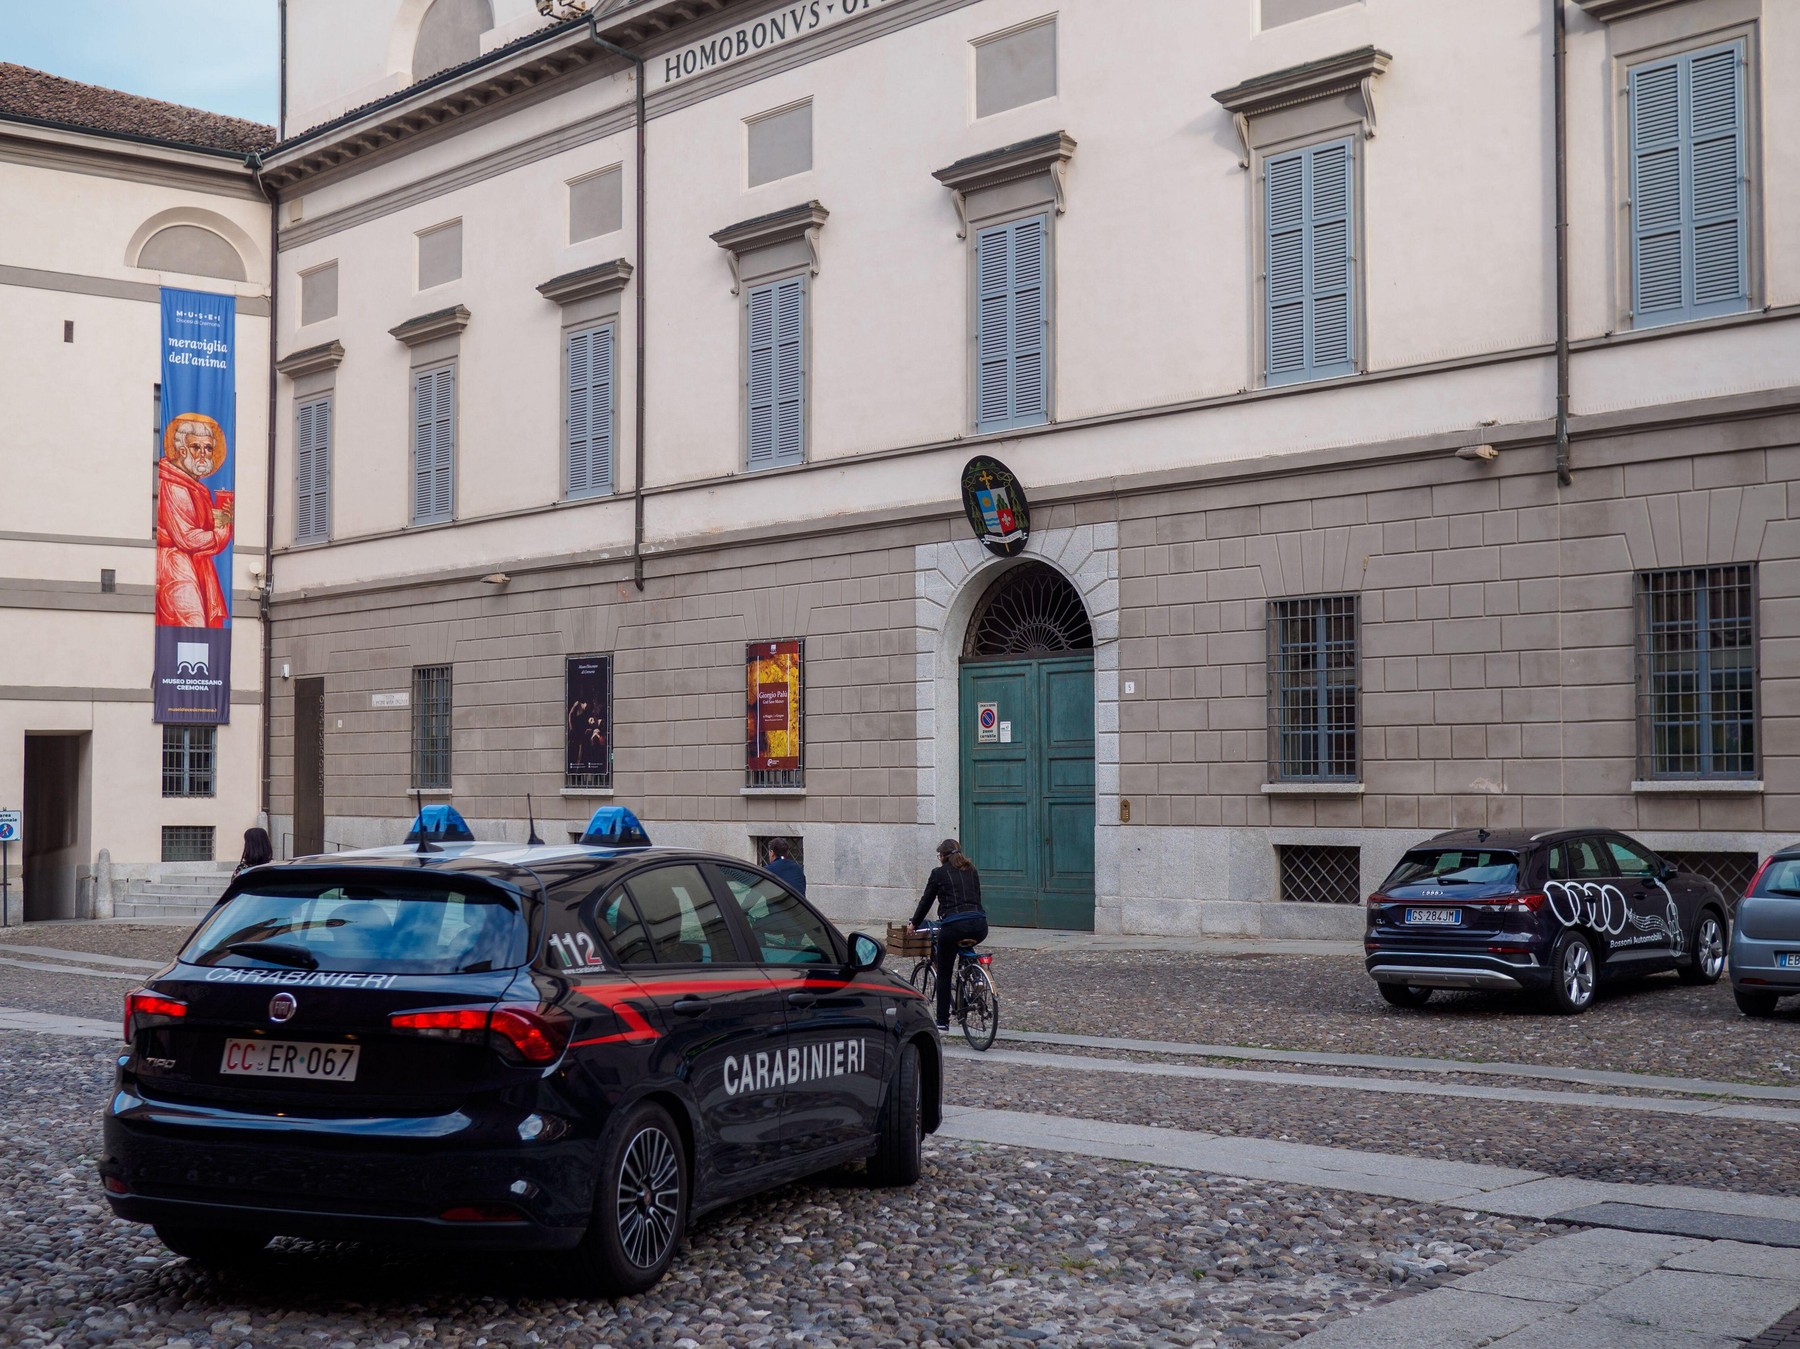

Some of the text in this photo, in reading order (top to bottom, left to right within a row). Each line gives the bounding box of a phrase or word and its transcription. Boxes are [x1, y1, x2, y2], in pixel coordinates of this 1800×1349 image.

[665, 1, 820, 82] HOMOBONVS
[168, 338, 227, 354] meraviglia
[169, 352, 227, 369] dell'anima
[1412, 910, 1454, 921] GS 284JM
[548, 931, 603, 967] 112
[1610, 936, 1633, 948] Bossoni
[205, 968, 398, 989] CARABINIERI
[275, 1001, 291, 1014] FIAT
[146, 1057, 177, 1069] TIPO
[226, 1042, 354, 1077] CC ER 067
[723, 1037, 866, 1096] CARABINIERI
